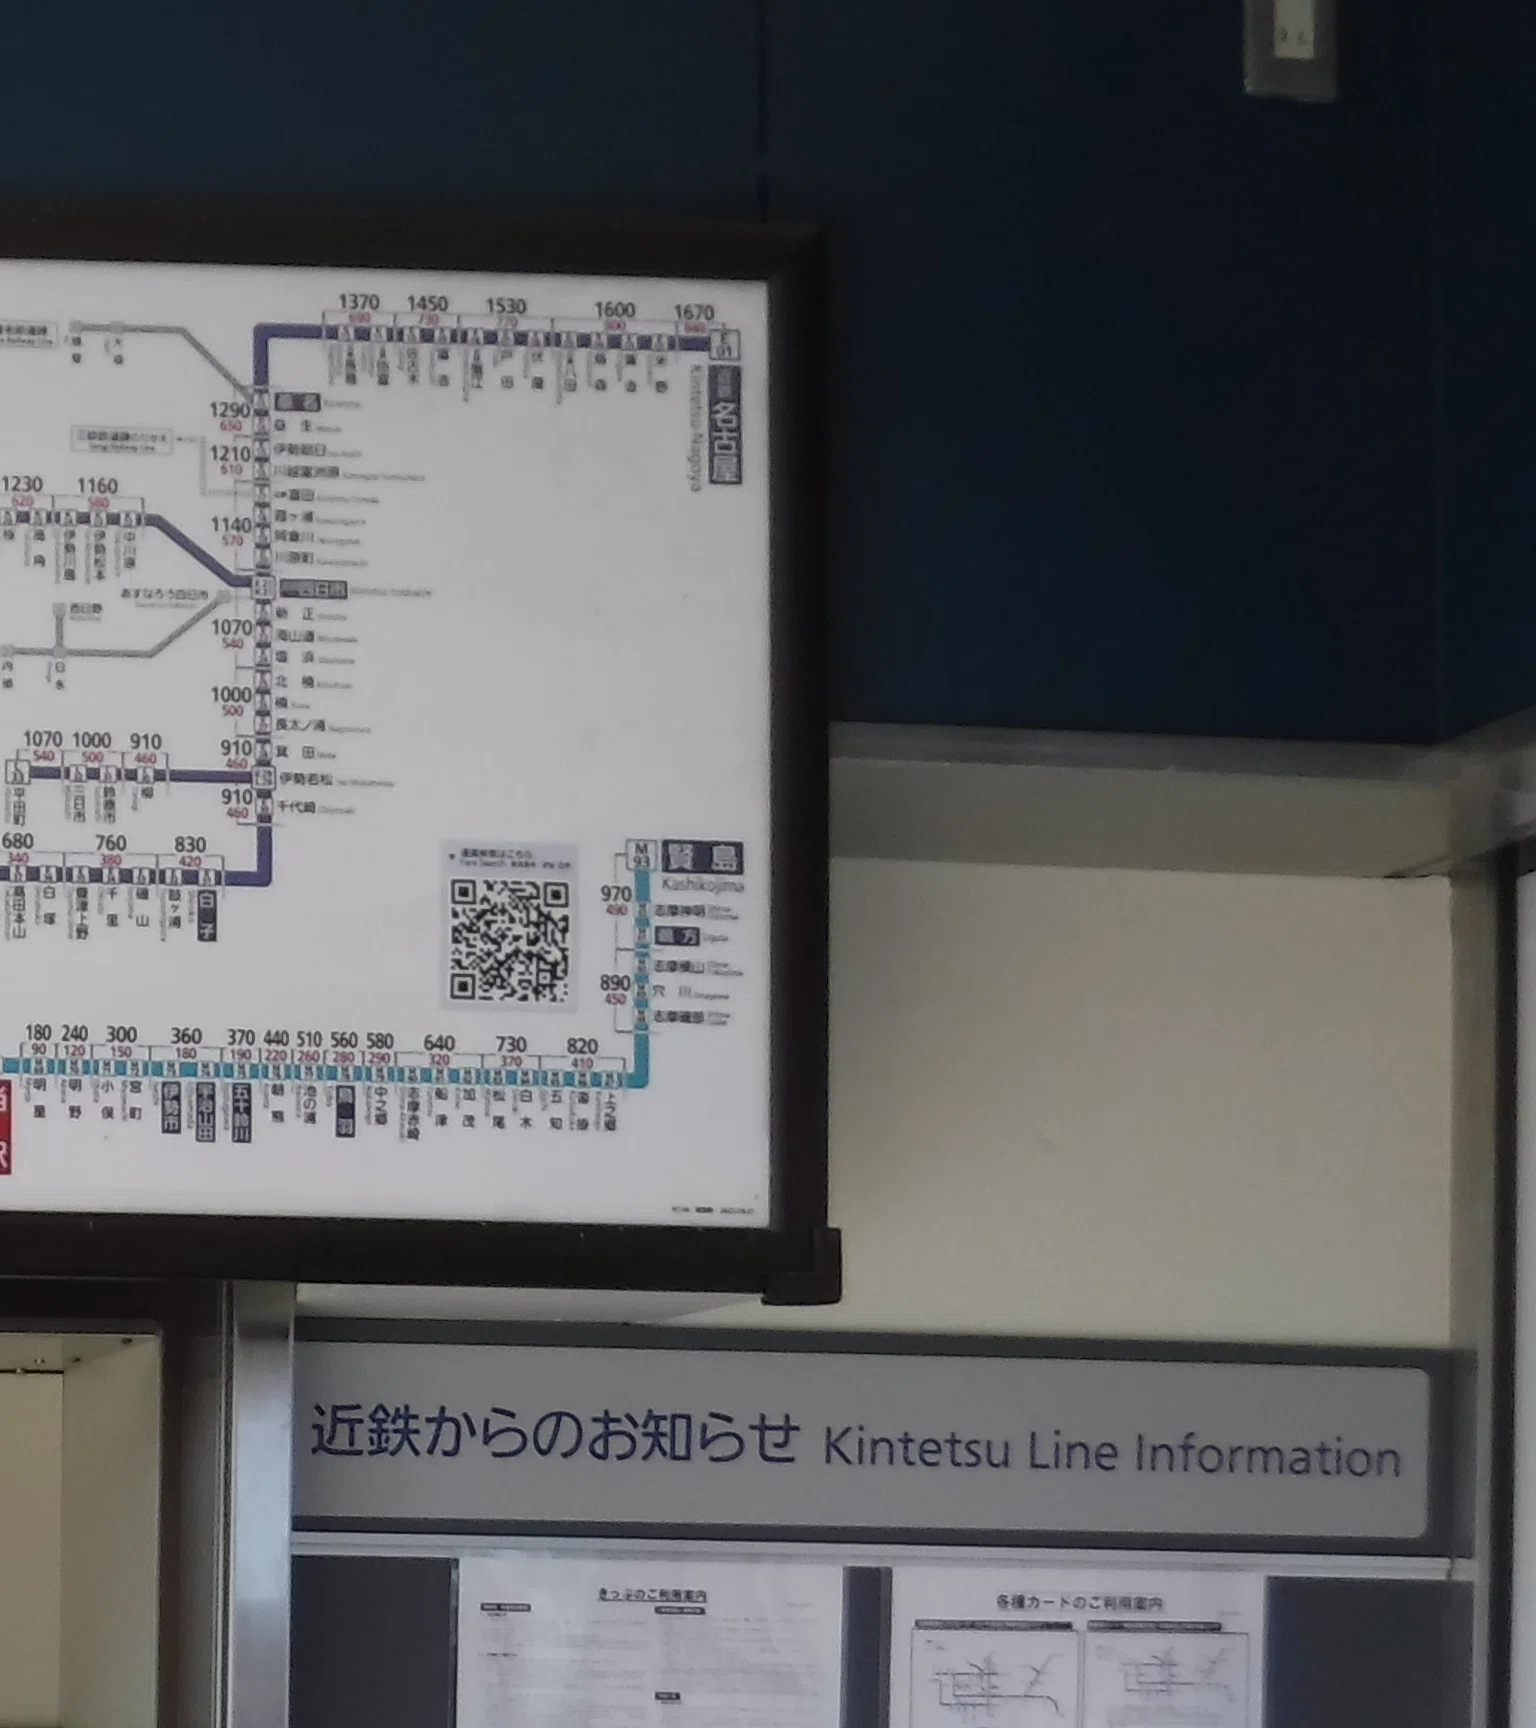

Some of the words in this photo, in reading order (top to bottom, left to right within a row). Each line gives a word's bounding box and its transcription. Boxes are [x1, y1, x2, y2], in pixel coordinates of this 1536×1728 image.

[339, 294, 380, 311] 1370
[486, 298, 526, 315] 1530
[595, 301, 635, 318] 1600
[211, 402, 251, 419] 1290
[211, 445, 251, 463] 1210
[2, 475, 43, 493] 1230
[211, 516, 252, 534] 1140
[211, 686, 252, 704] 1000
[73, 732, 111, 748] 1000
[131, 733, 161, 750] 910
[222, 789, 252, 805] 910
[96, 835, 126, 850] 760
[175, 836, 206, 852] 830
[601, 886, 631, 901] 970
[62, 1025, 88, 1042] 240
[106, 1026, 137, 1043] 300
[228, 1030, 255, 1046] 370
[264, 1030, 289, 1046] 440
[331, 1032, 358, 1048] 560
[424, 1034, 455, 1051] 640
[496, 1036, 527, 1052] 730
[311, 1404, 800, 1464] 近鉄からのお知らせ
[825, 1424, 1010, 1469] Kintetsu
[1028, 1428, 1118, 1471] Line
[1135, 1432, 1402, 1481] Information
